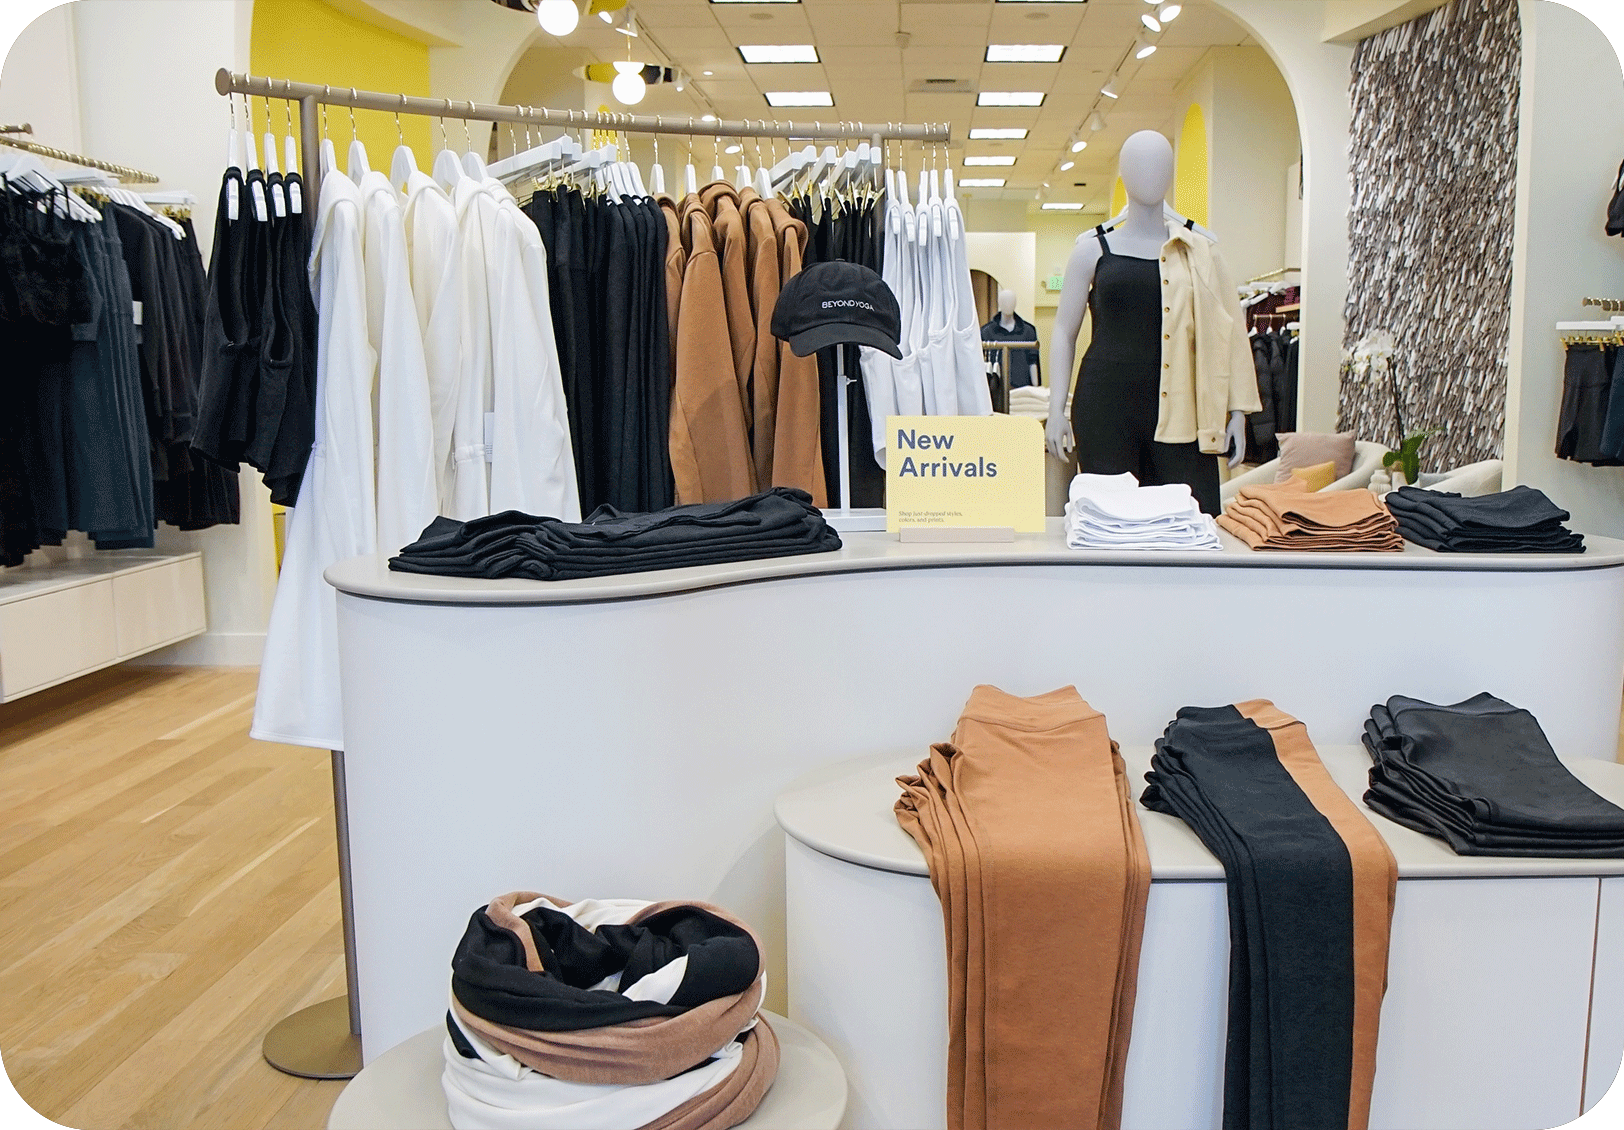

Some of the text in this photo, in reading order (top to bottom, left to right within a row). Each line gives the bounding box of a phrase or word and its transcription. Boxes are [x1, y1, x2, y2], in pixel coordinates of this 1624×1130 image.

[822, 300, 875, 312] BEYOND YOGA
[897, 429, 955, 450] New
[899, 456, 997, 478] Arrivals
